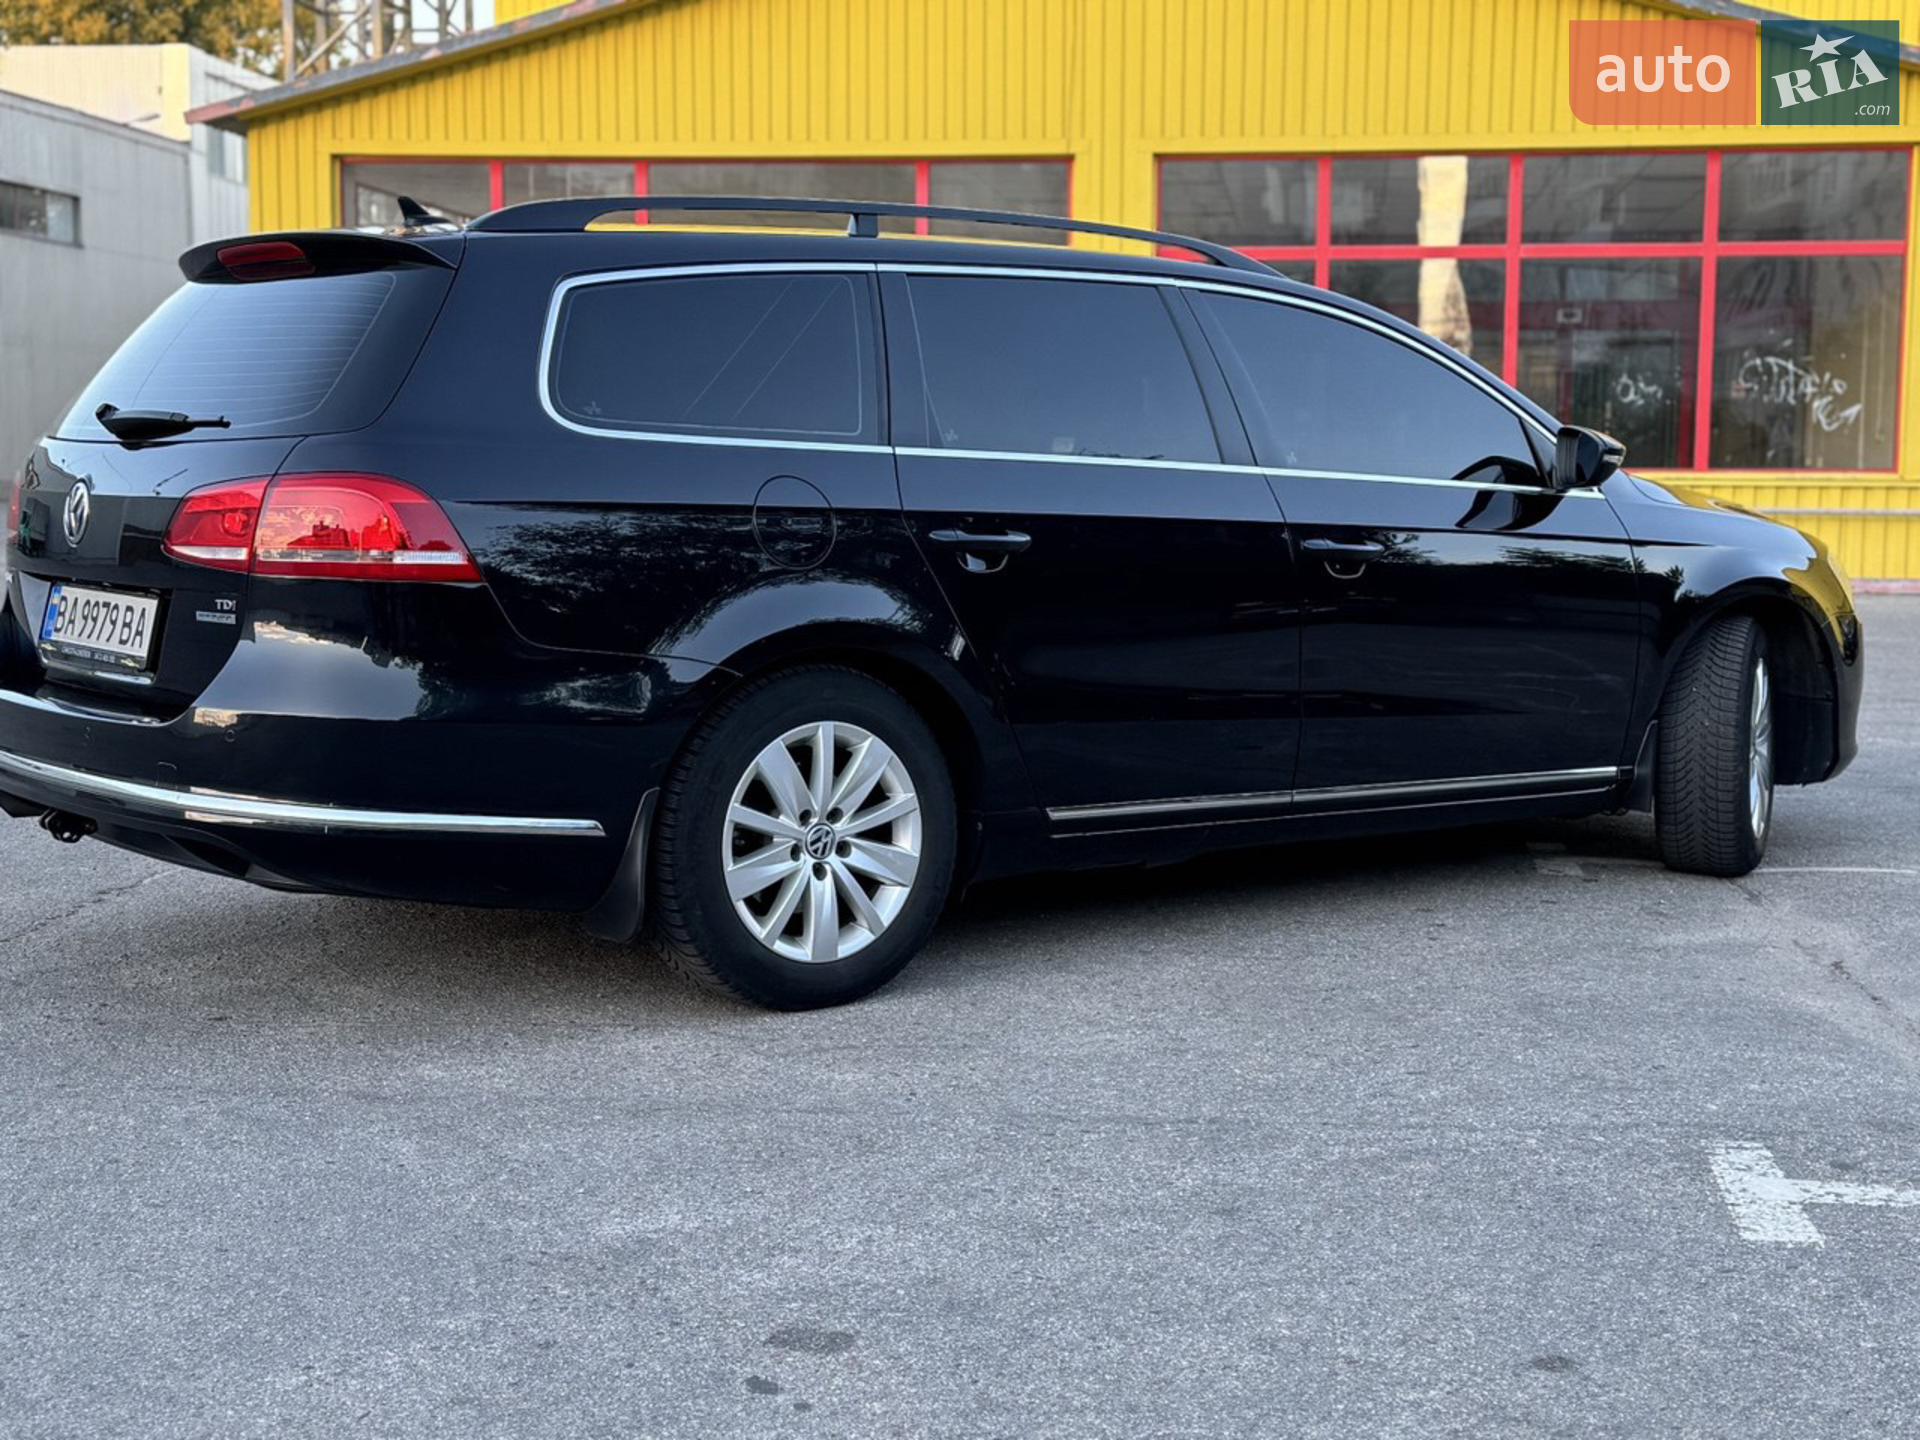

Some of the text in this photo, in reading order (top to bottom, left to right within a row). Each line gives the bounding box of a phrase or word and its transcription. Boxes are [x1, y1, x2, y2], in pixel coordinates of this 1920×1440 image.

[53, 595, 147, 649] BA 9979 BA
